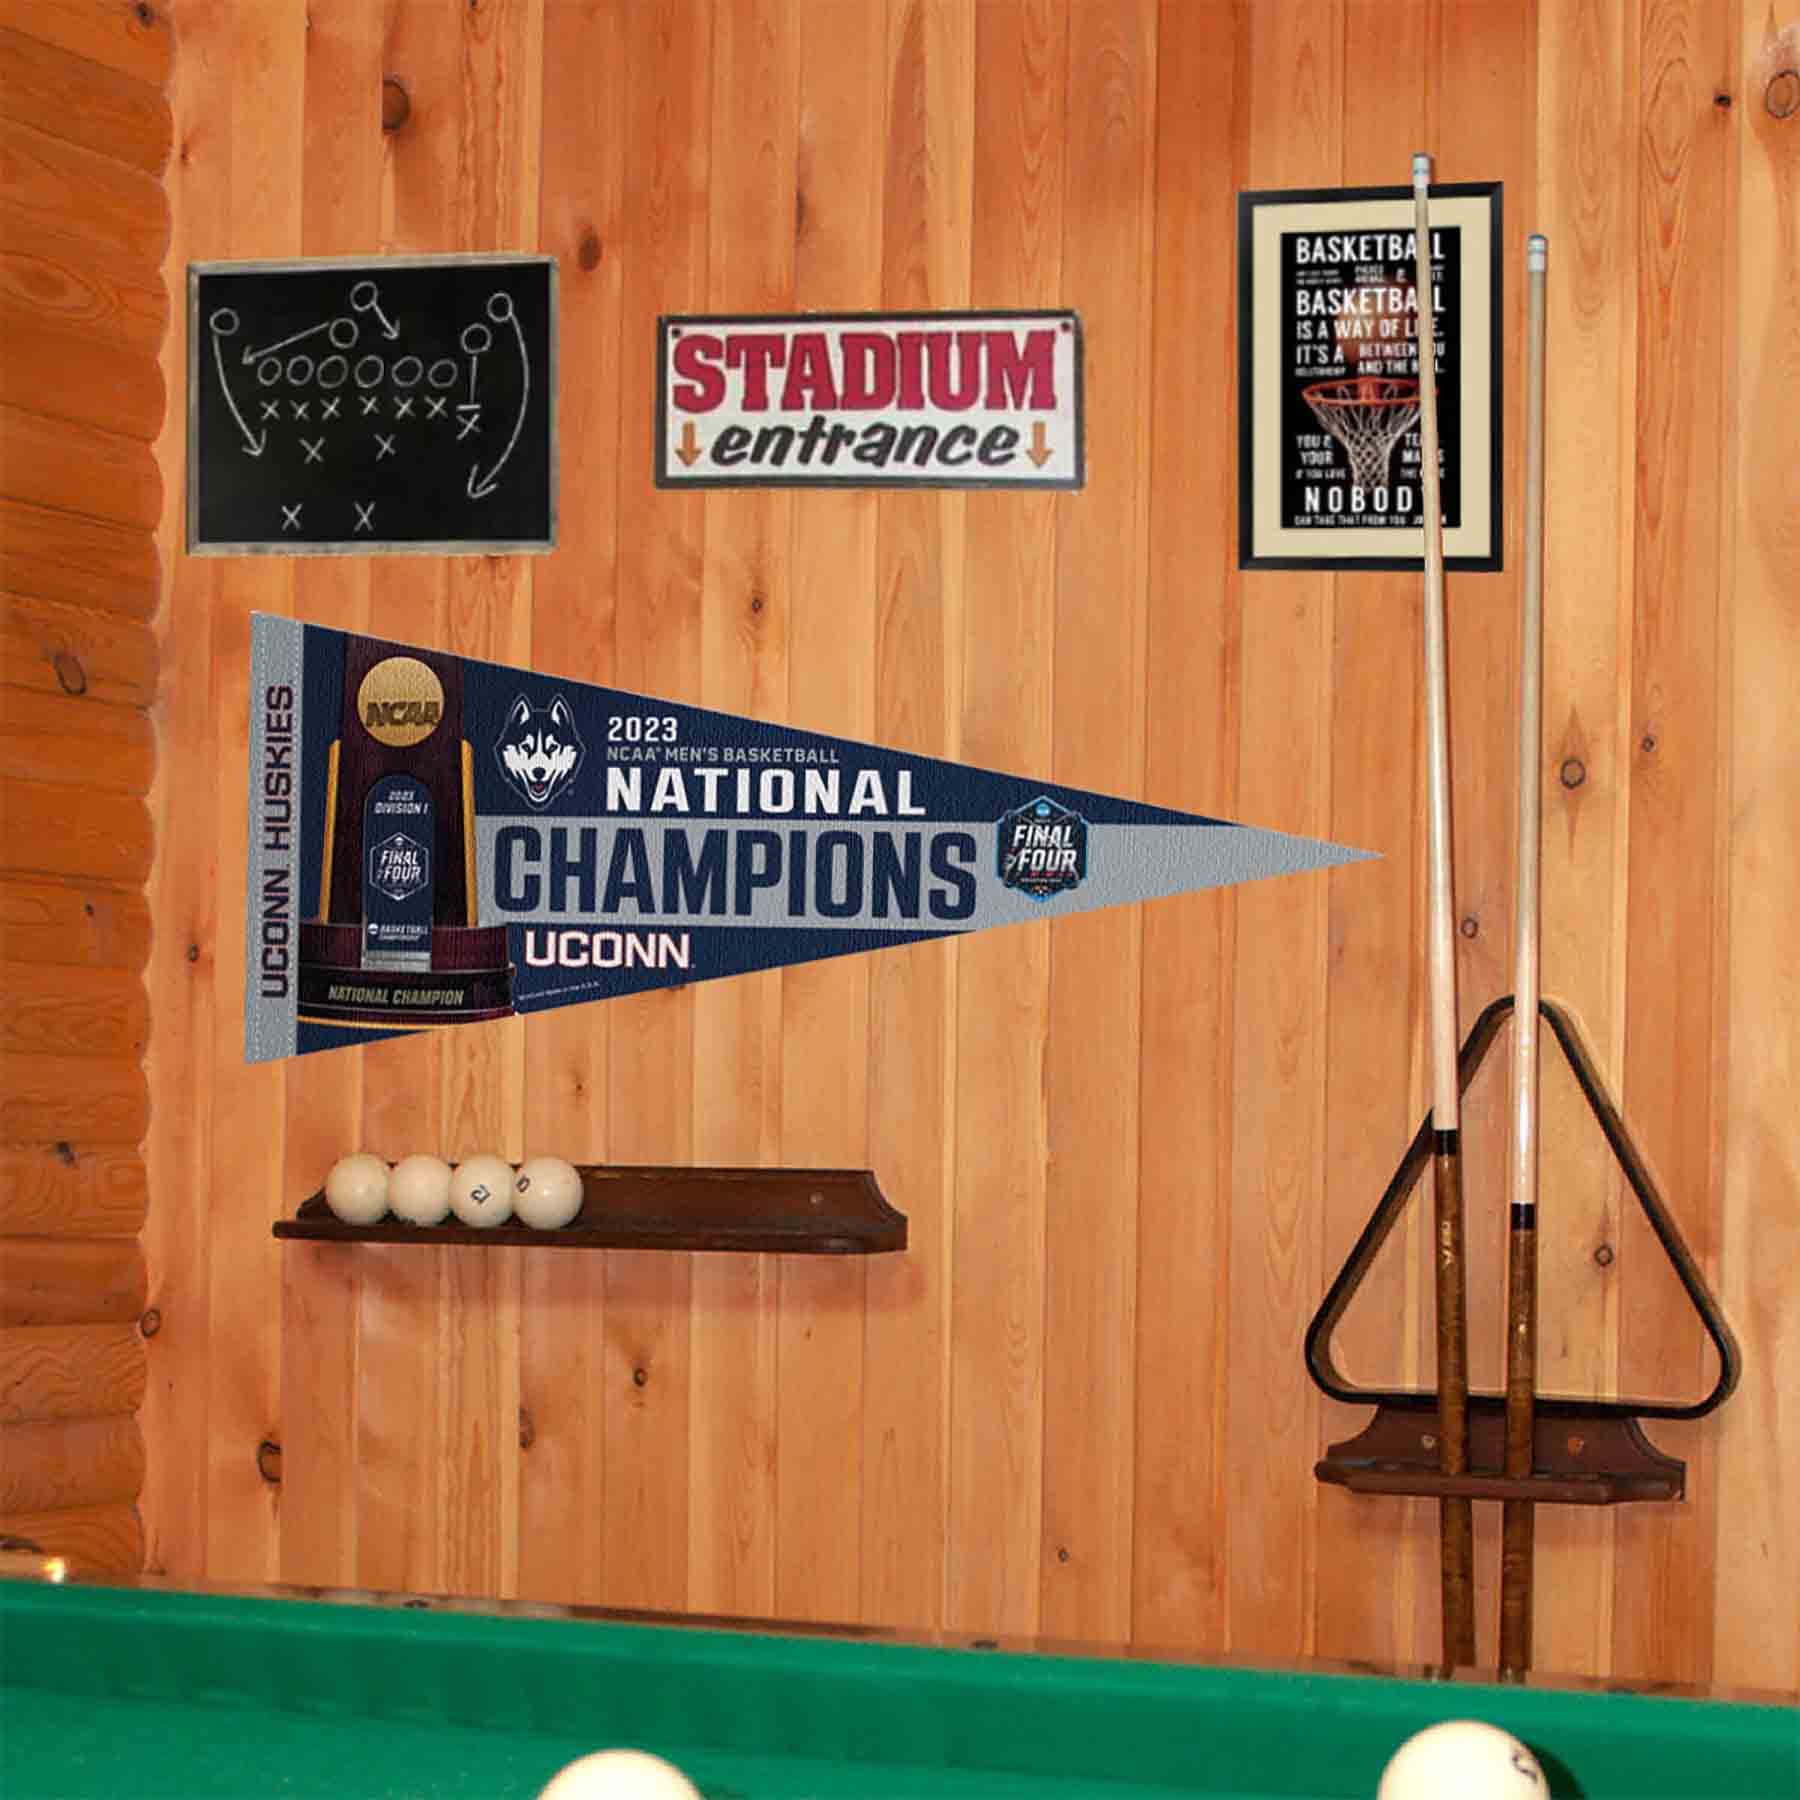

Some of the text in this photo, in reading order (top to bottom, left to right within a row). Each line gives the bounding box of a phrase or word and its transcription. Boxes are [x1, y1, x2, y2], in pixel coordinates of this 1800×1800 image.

[1296, 232, 1446, 264] BASKETBAL
[1296, 285, 1447, 316] BASKETBAL
[1296, 320, 1313, 341] IS
[1317, 320, 1330, 340] A
[1333, 319, 1375, 338] WAY
[1378, 318, 1401, 337] OF
[1296, 344, 1346, 365] IT'S A
[672, 329, 1057, 413] STADIUM
[711, 415, 1021, 468] entrance
[1304, 485, 1424, 513] NOBOD
[366, 701, 440, 727] NCAA
[608, 716, 678, 743] 2023
[665, 747, 719, 762] MEN'S
[723, 748, 840, 764] BASKETBALL
[606, 767, 926, 816] NATIONAL
[374, 802, 423, 815] DIVISION
[261, 685, 294, 999] UCONN HUSKIES
[1012, 825, 1074, 848] FINAL
[380, 850, 418, 865] FINAL
[1017, 848, 1078, 873] FOUR
[382, 865, 422, 881] FOUR
[494, 825, 977, 921] CHAMPIONS
[524, 928, 692, 970] UCONN
[327, 983, 465, 1006] NATIONAL CHAMPION
